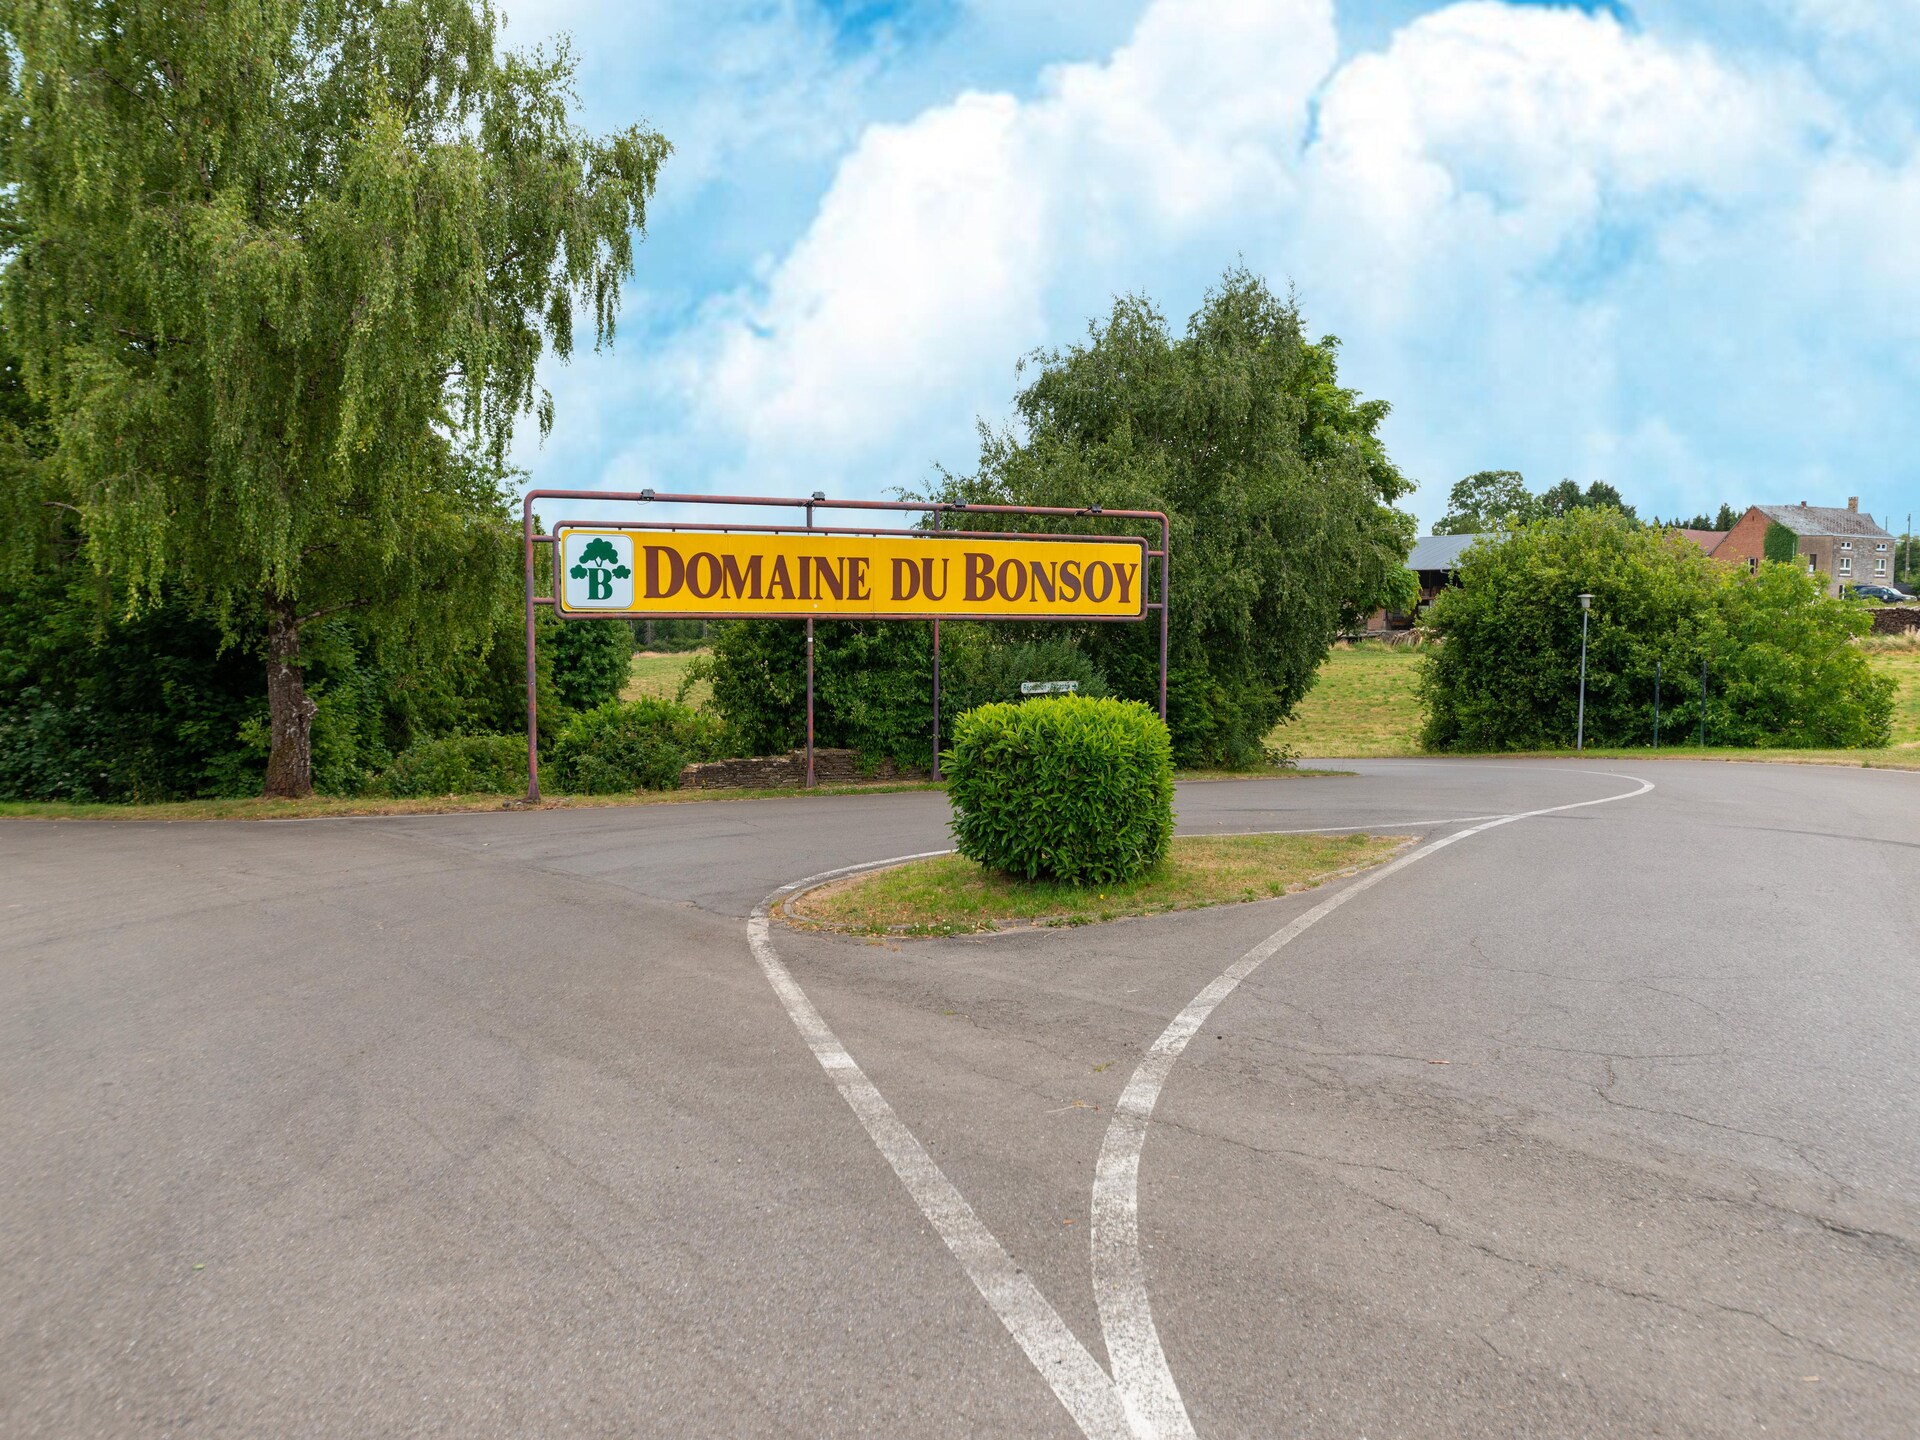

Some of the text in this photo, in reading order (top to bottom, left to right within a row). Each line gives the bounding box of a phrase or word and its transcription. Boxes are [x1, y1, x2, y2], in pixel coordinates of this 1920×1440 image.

[587, 567, 613, 600] B
[642, 545, 1139, 604] DOMAINE DU BONSOY
